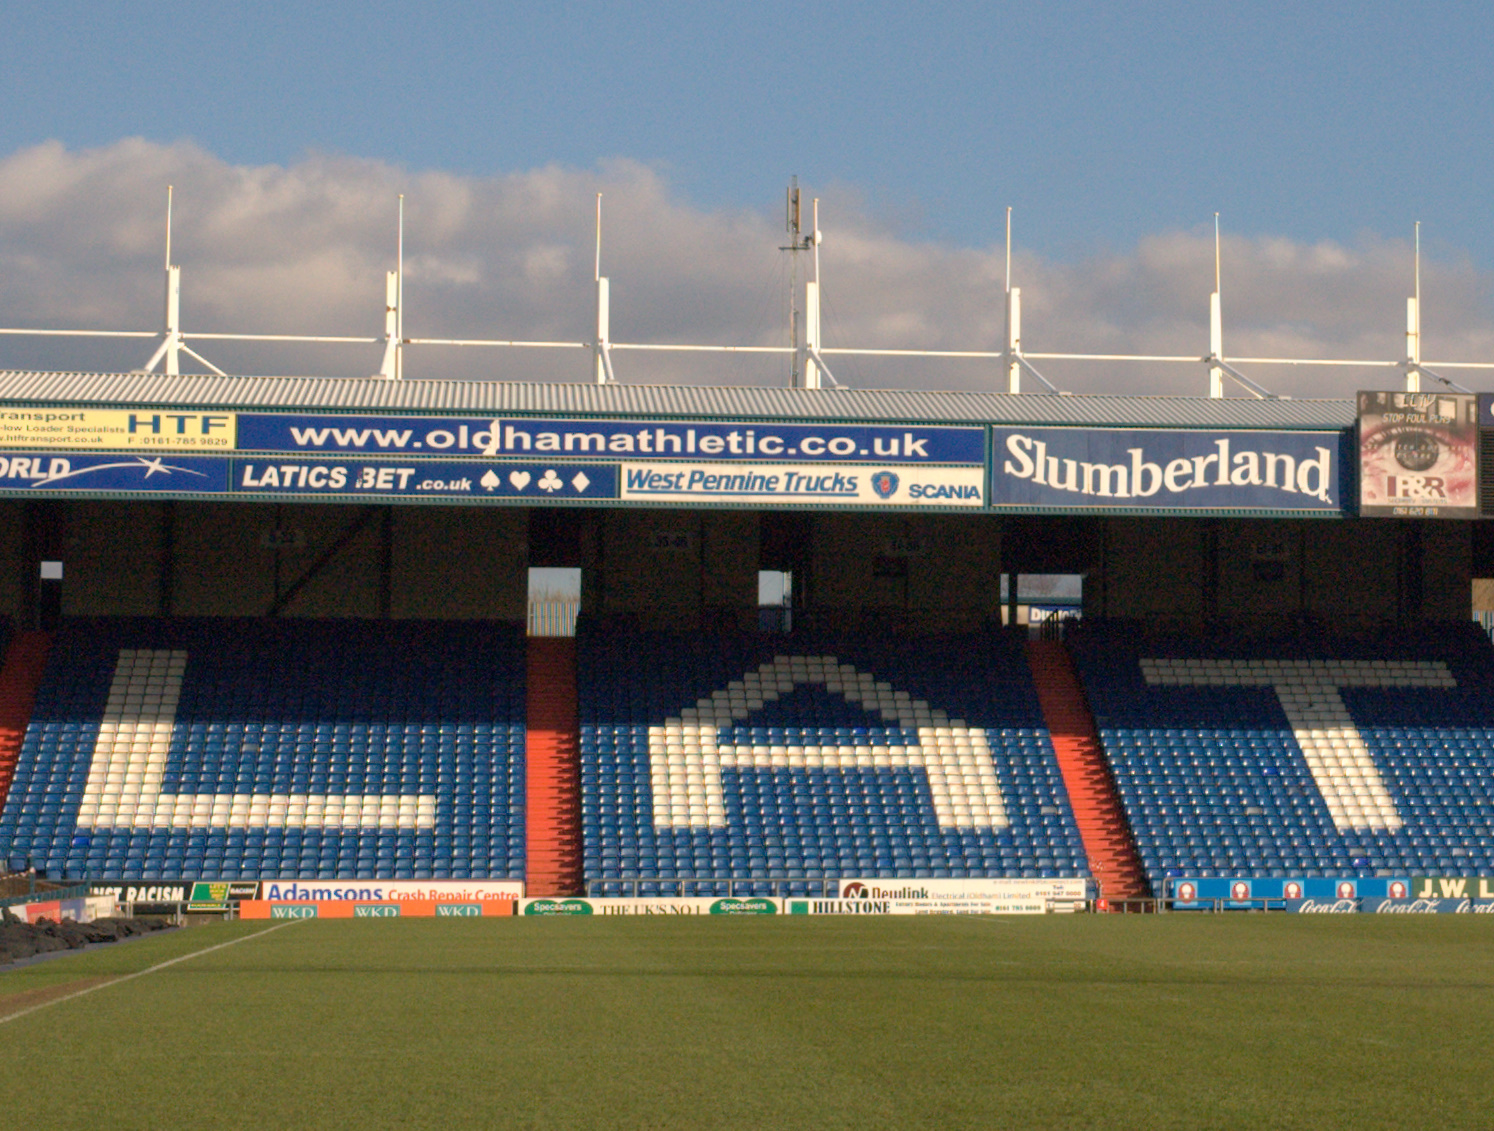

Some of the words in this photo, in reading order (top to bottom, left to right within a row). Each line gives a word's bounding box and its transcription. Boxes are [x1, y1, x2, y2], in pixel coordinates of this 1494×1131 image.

[26, 424, 64, 433] Loader
[66, 425, 126, 435] Specialists
[128, 414, 230, 434] HTF
[290, 420, 929, 456] www.oldhamathletic.co.uk
[1004, 434, 1332, 504] Slumberland
[242, 465, 348, 488] LATICS
[355, 467, 416, 489] BET
[416, 476, 472, 492] .co.uk
[626, 469, 686, 489] West
[688, 470, 779, 492] Pennine
[784, 472, 860, 493] Trucks
[908, 483, 982, 500] SCANIA
[126, 886, 185, 902] RACISM
[267, 883, 383, 901] Adamsons
[388, 889, 428, 901] Crash
[429, 889, 473, 901] Repair
[475, 890, 519, 901] Centre
[1418, 879, 1469, 898] J.W.
[272, 905, 315, 918] WKD
[354, 905, 398, 918] WKD
[436, 904, 480, 917] WKD
[534, 902, 582, 912] Specsavers
[600, 905, 631, 915] THE
[720, 902, 767, 912] Specsavers
[813, 901, 891, 914] HILLSTONE
[1299, 899, 1363, 913] Coca-Cola
[1376, 899, 1441, 913] Coca-Cola
